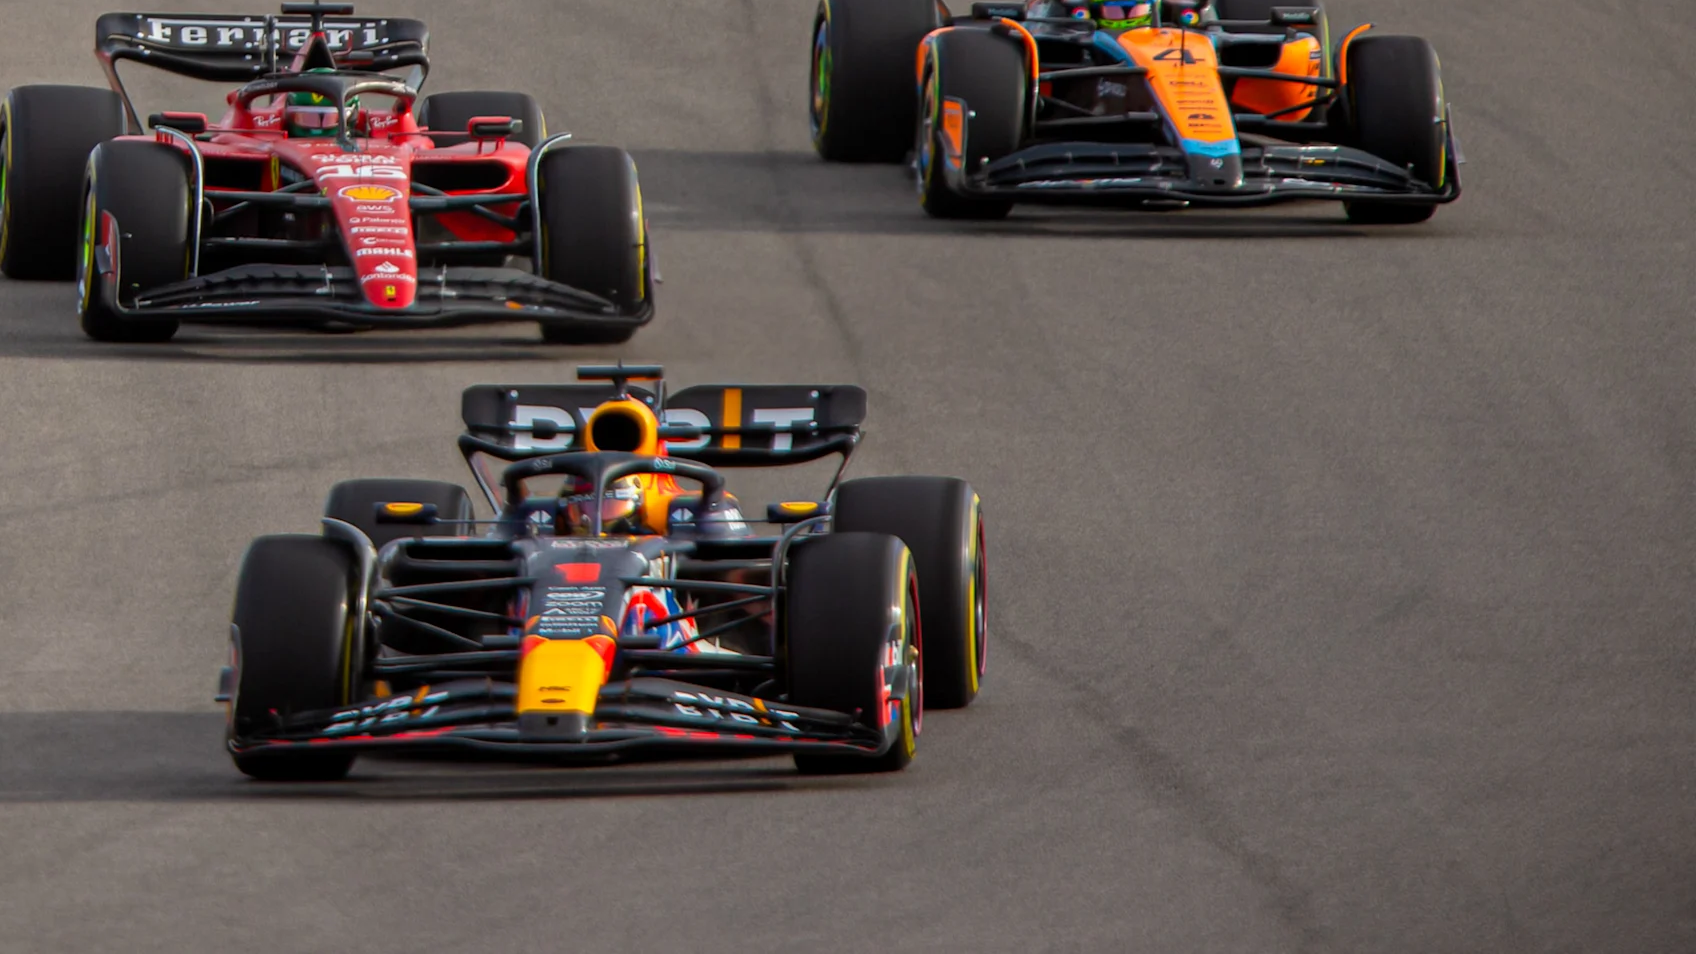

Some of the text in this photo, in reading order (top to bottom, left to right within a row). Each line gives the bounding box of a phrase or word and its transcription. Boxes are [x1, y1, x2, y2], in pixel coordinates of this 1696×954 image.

[1153, 48, 1206, 64] 4
[316, 164, 407, 182] 16
[356, 247, 413, 258] MAHLE
